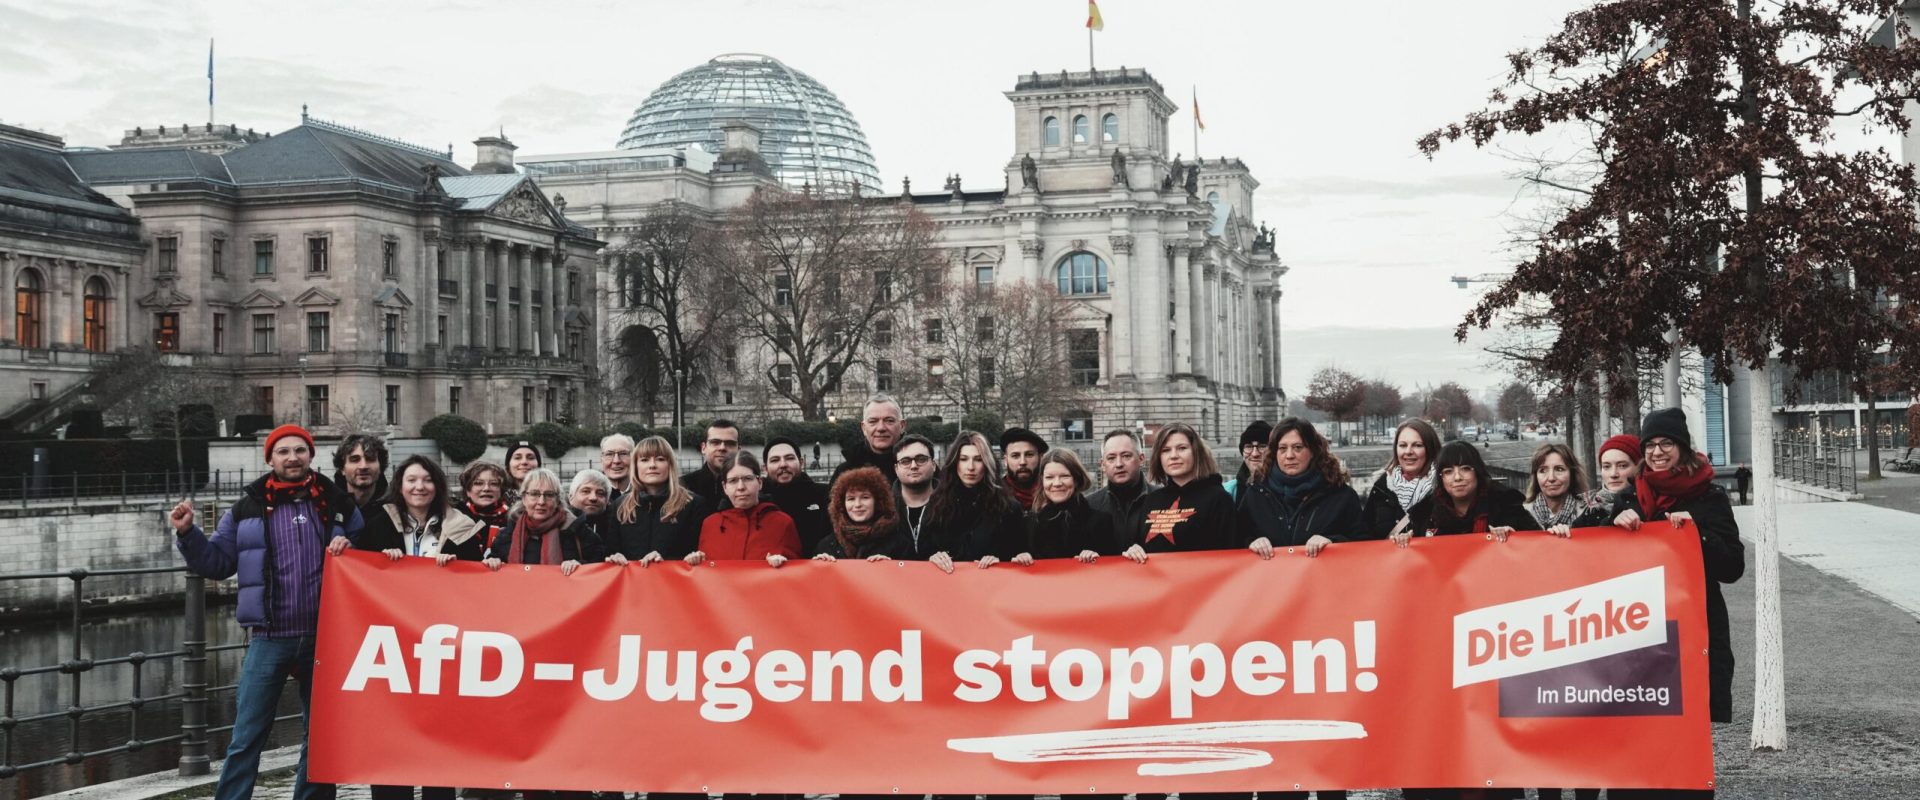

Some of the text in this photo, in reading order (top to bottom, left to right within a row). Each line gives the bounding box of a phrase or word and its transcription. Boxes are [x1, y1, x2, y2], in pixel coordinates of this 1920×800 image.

[1467, 598, 1651, 668] Die Linke
[341, 620, 1379, 723] AfD-Jugend stoppen!
[1537, 685, 1670, 706] Im Bundestag
